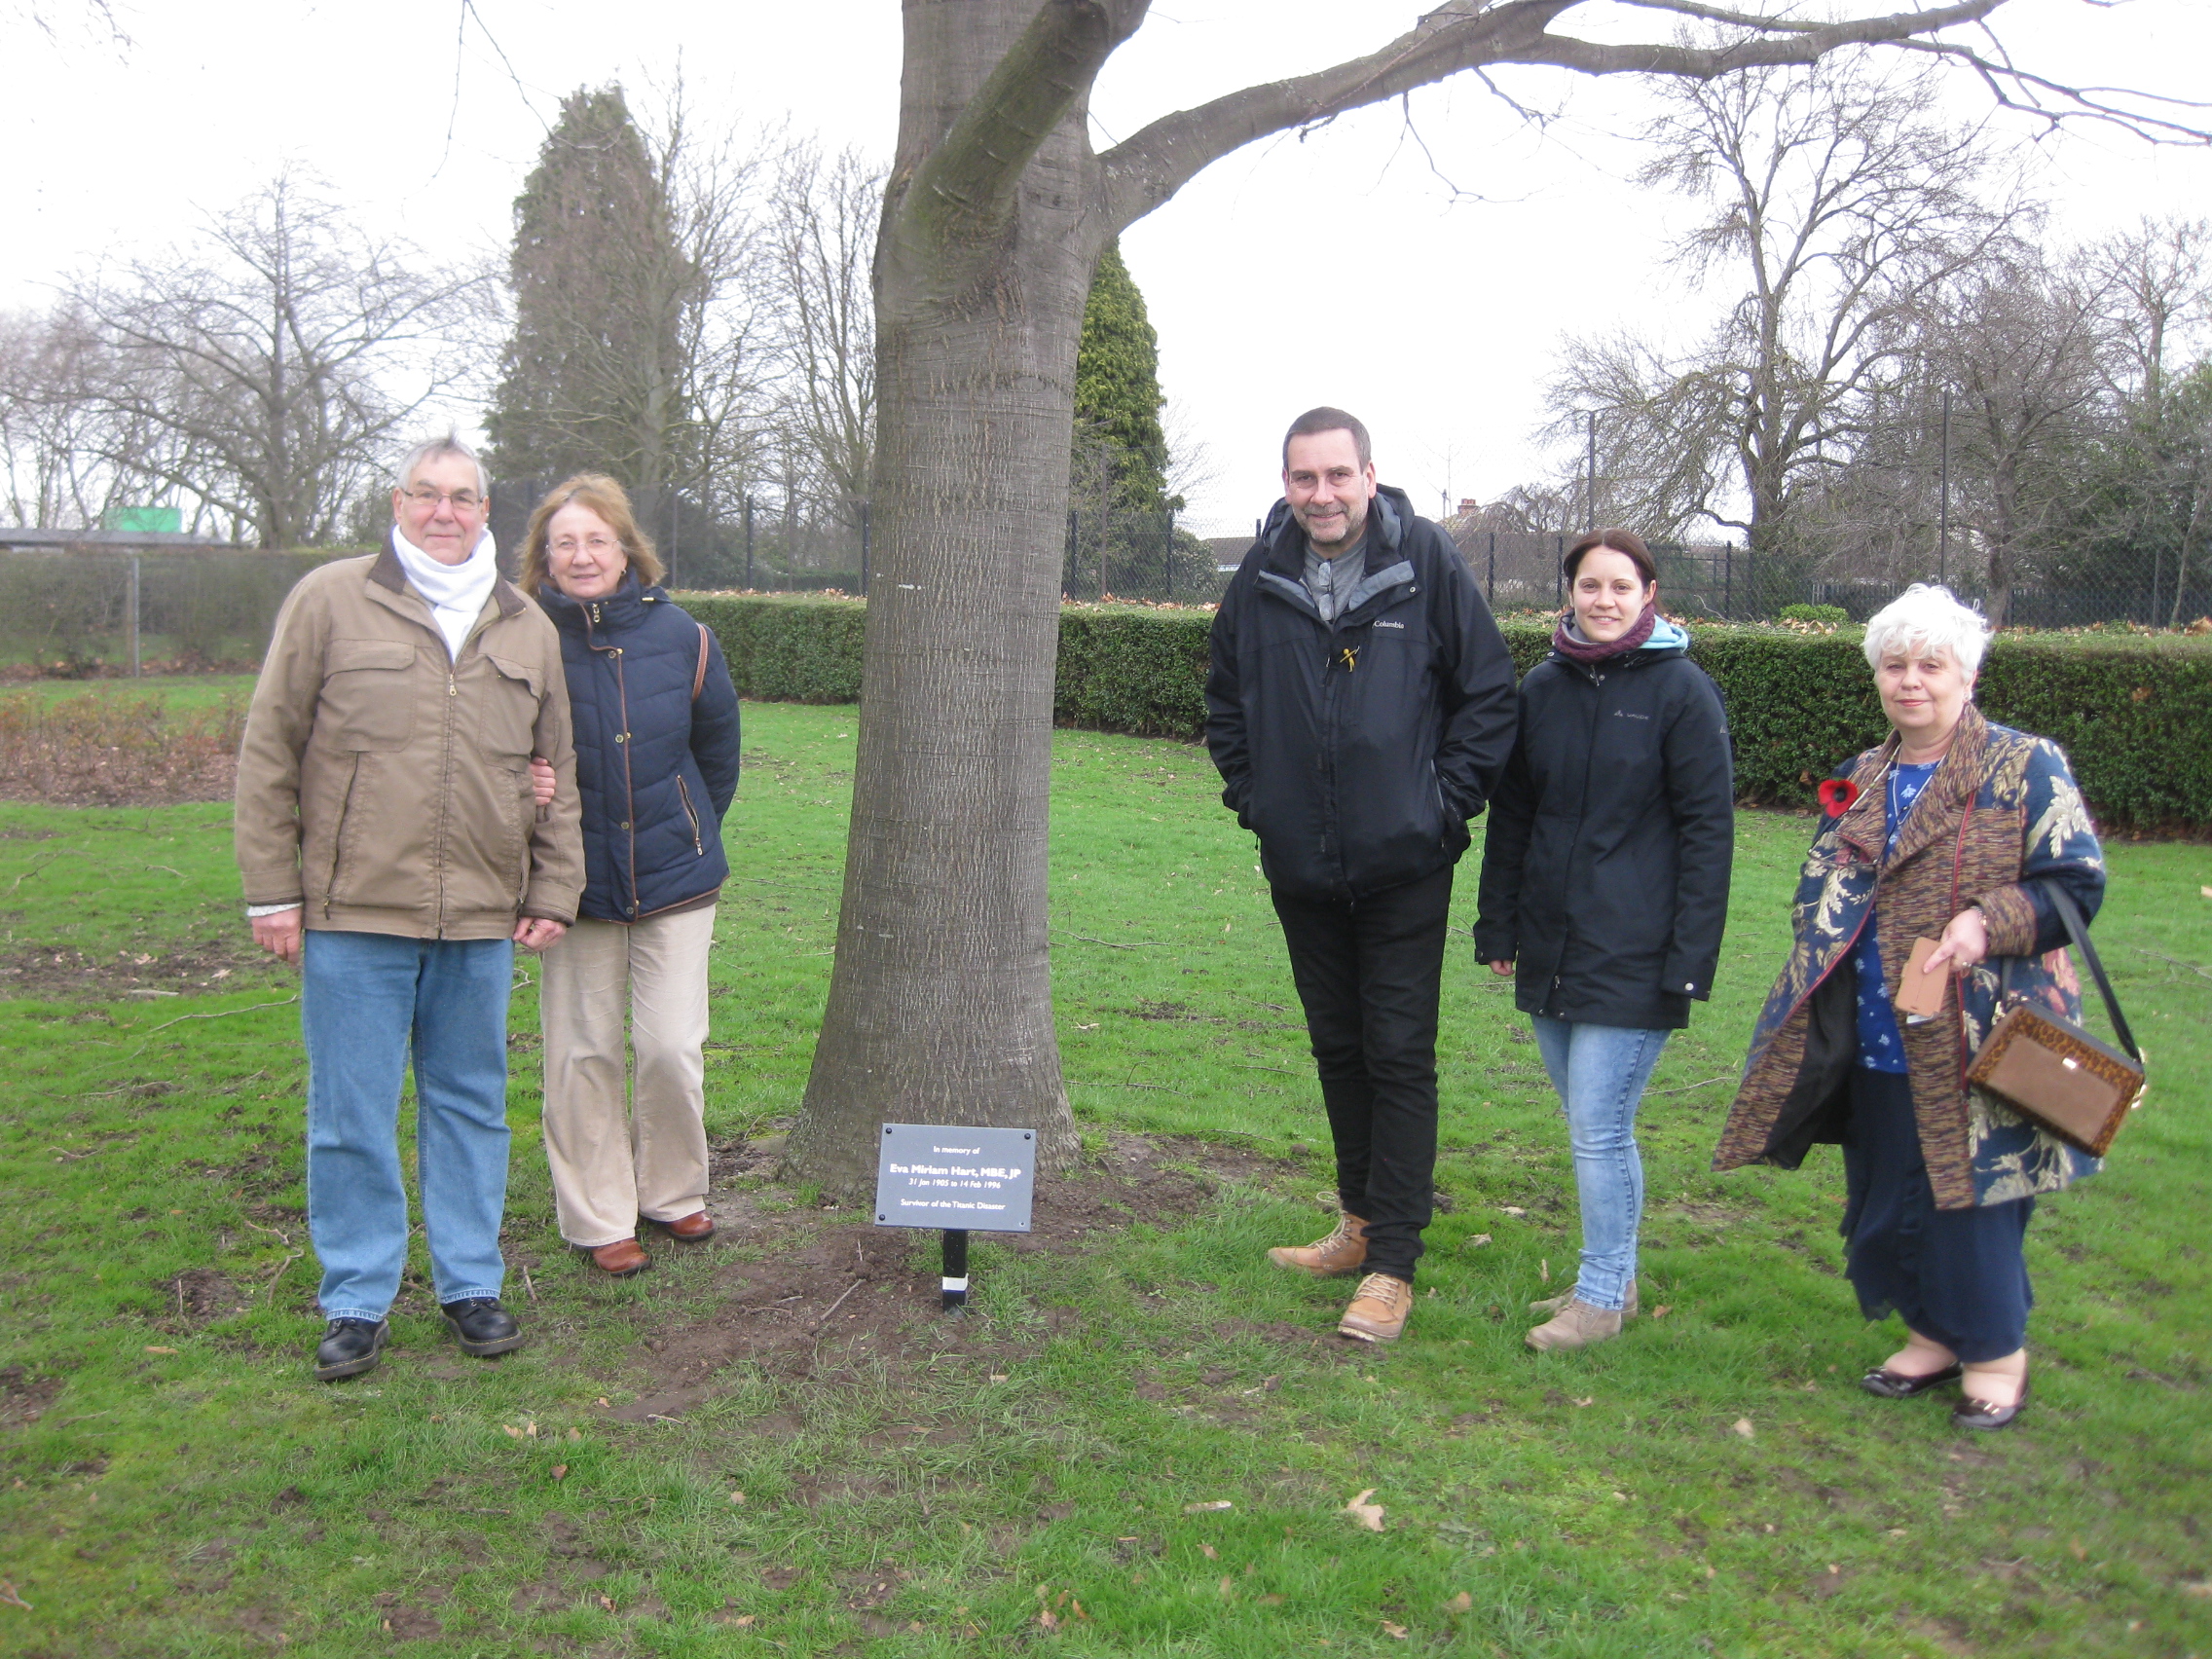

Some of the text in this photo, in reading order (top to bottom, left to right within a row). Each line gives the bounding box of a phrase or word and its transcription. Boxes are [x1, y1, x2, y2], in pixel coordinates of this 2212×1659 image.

[1374, 620, 1405, 629] Columbia
[941, 1147, 971, 1157] memory
[889, 1162, 1022, 1180] Eva Miriam Hart, MBE, JP
[908, 1177, 917, 1186] 31
[917, 1178, 930, 1188] Jan
[932, 1178, 950, 1187] 1905
[969, 1180, 982, 1189] Feb
[983, 1181, 1002, 1190] 1996
[900, 1198, 930, 1207] Survivor
[940, 1199, 952, 1208] the
[951, 1200, 976, 1209] Titanic
[977, 1201, 1007, 1210] Disaster
